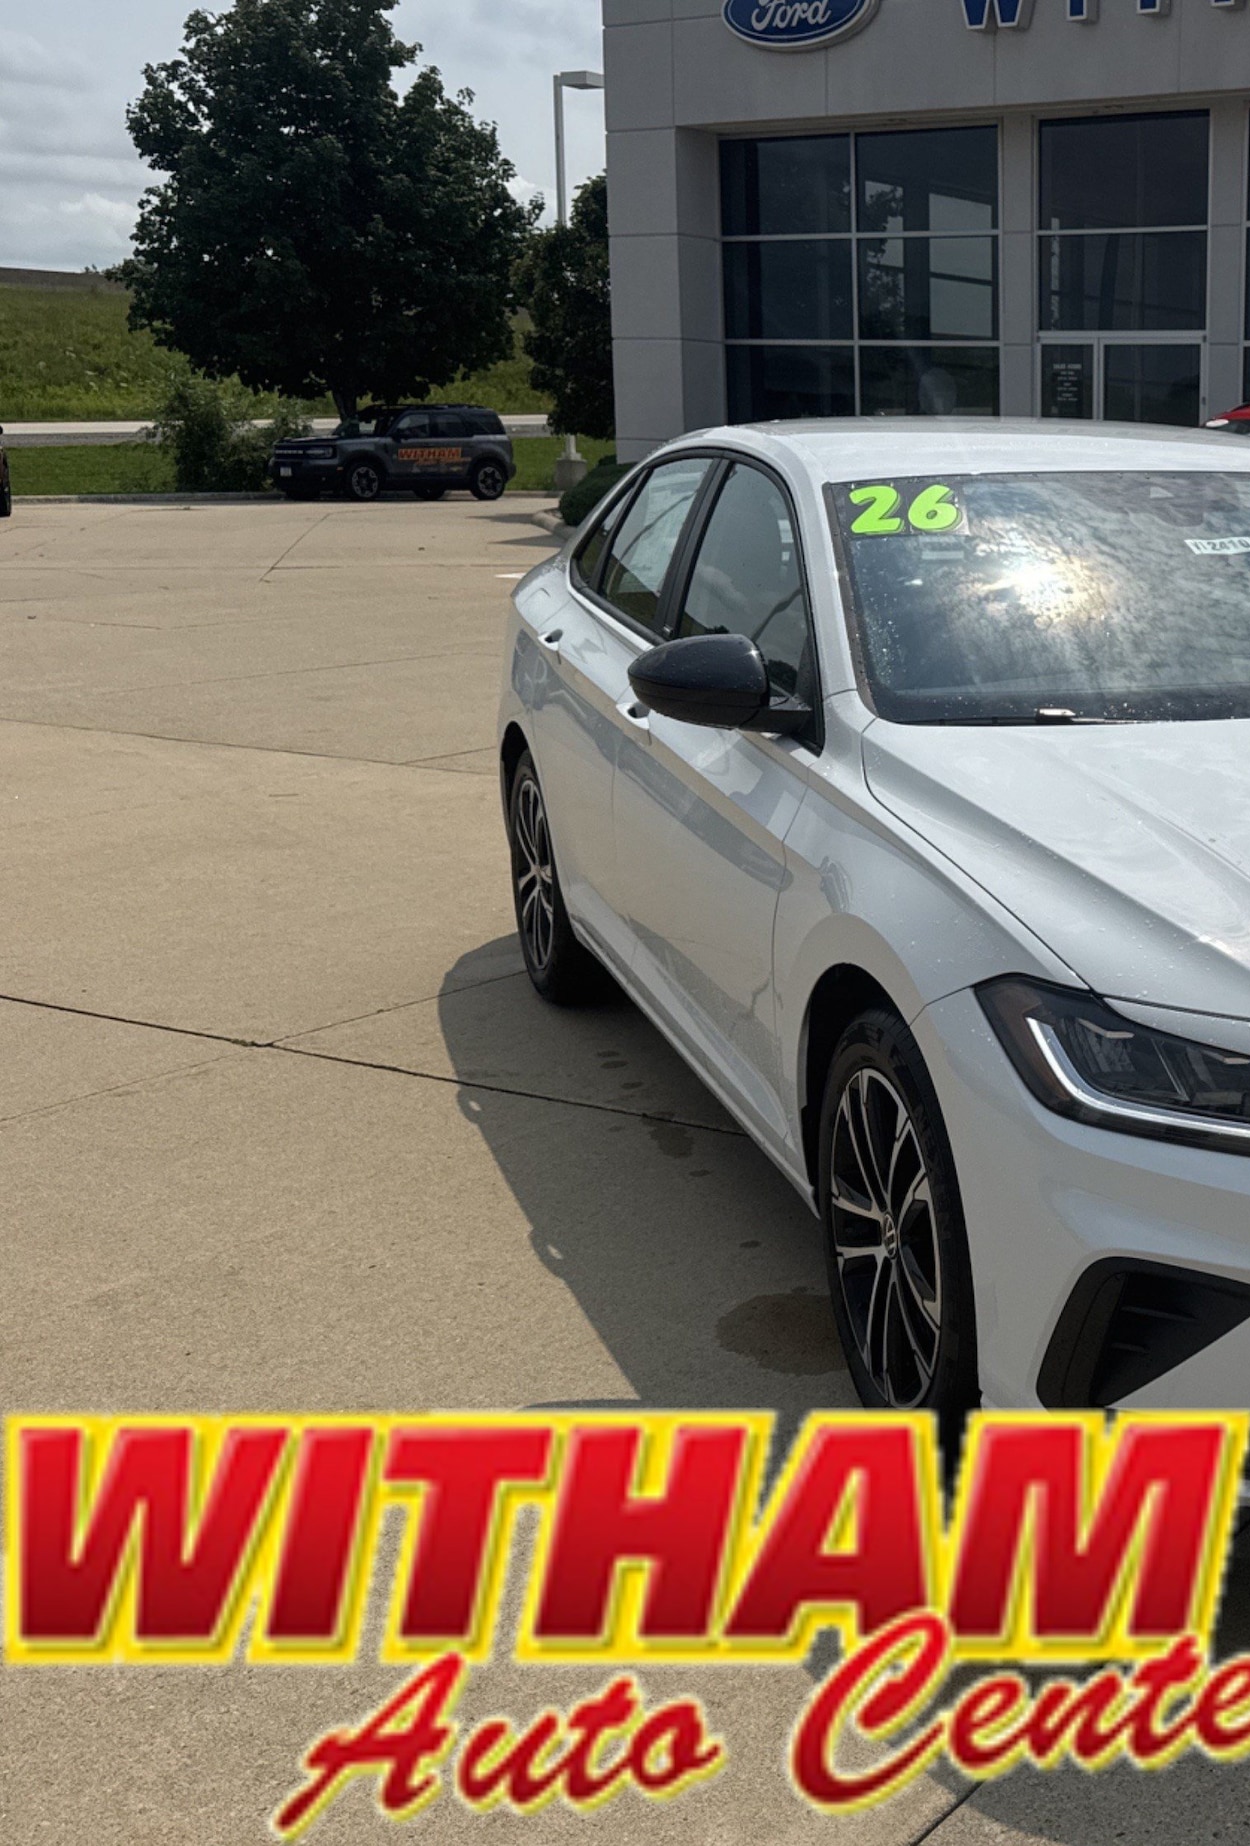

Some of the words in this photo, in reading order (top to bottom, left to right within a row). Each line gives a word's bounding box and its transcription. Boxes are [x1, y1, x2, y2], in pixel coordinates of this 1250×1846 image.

[751, 0, 832, 31] Ford
[398, 448, 461, 460] WITHAM
[848, 483, 963, 535] 26
